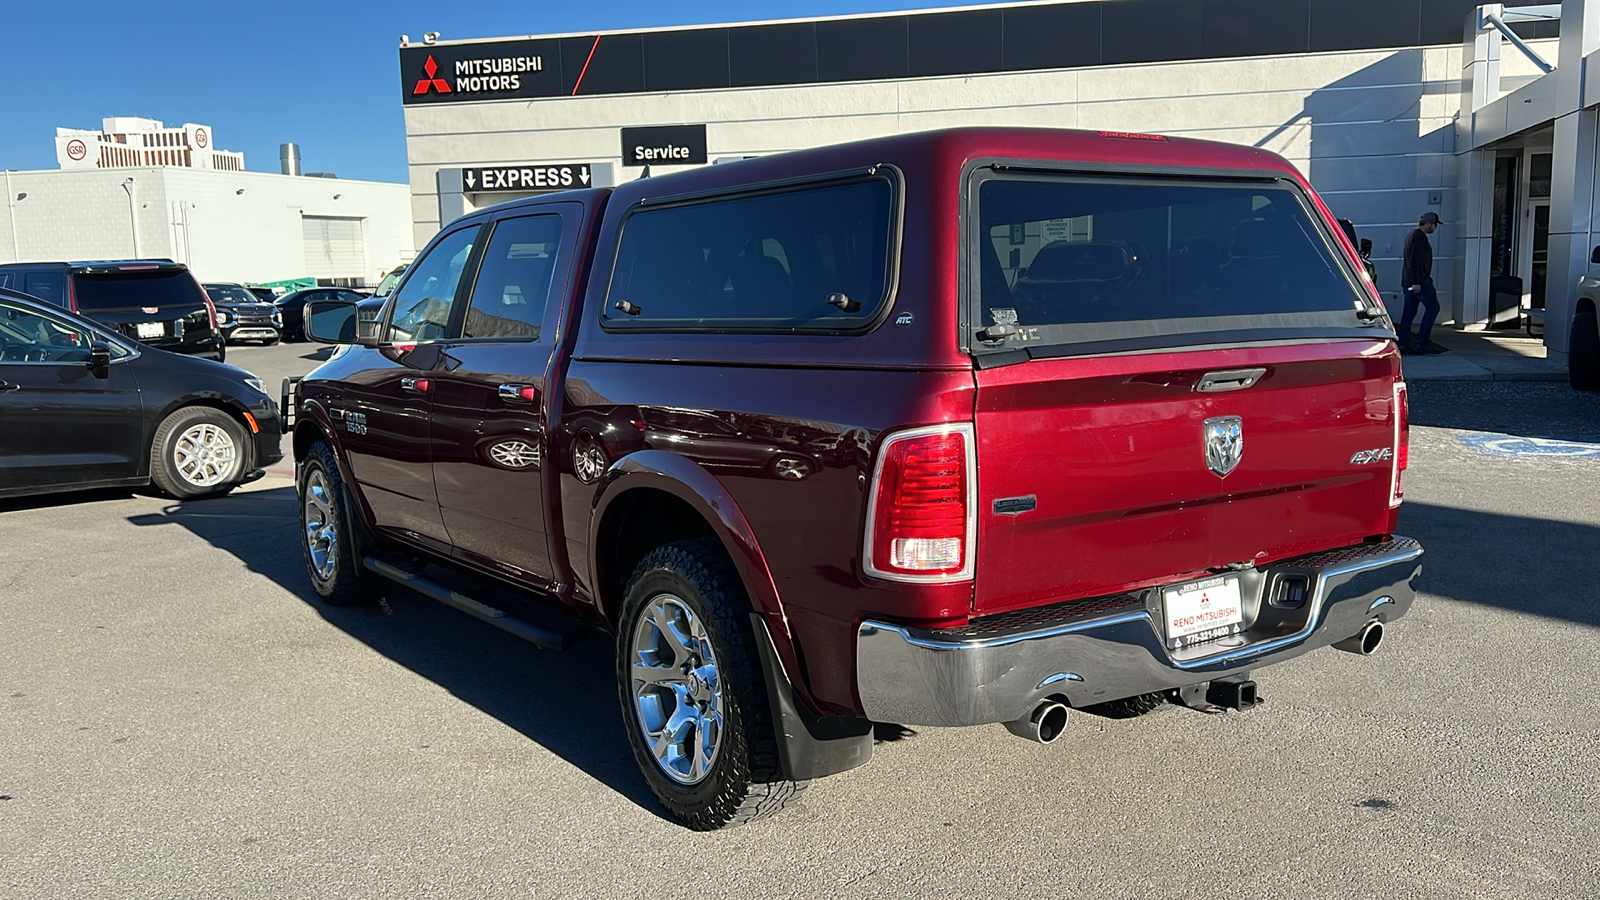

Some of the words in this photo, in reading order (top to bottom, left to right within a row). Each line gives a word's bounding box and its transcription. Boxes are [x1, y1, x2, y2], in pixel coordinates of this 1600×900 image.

[455, 56, 543, 75] MITSUBISHI
[456, 75, 520, 92] MOTORS
[69, 145, 84, 155] GSR
[635, 144, 690, 160] Service
[481, 167, 573, 188] EXPRESS
[895, 316, 912, 324] ATC
[345, 410, 367, 424] RAM
[346, 421, 367, 435] 1500
[1350, 447, 1392, 465] 4X4
[1183, 583, 1198, 592] RENO
[1198, 577, 1224, 589] MITSUBISHI
[1173, 616, 1195, 628] RENO
[1196, 607, 1237, 623] MITSUBISHI
[1186, 626, 1229, 644] 775-321-9400
